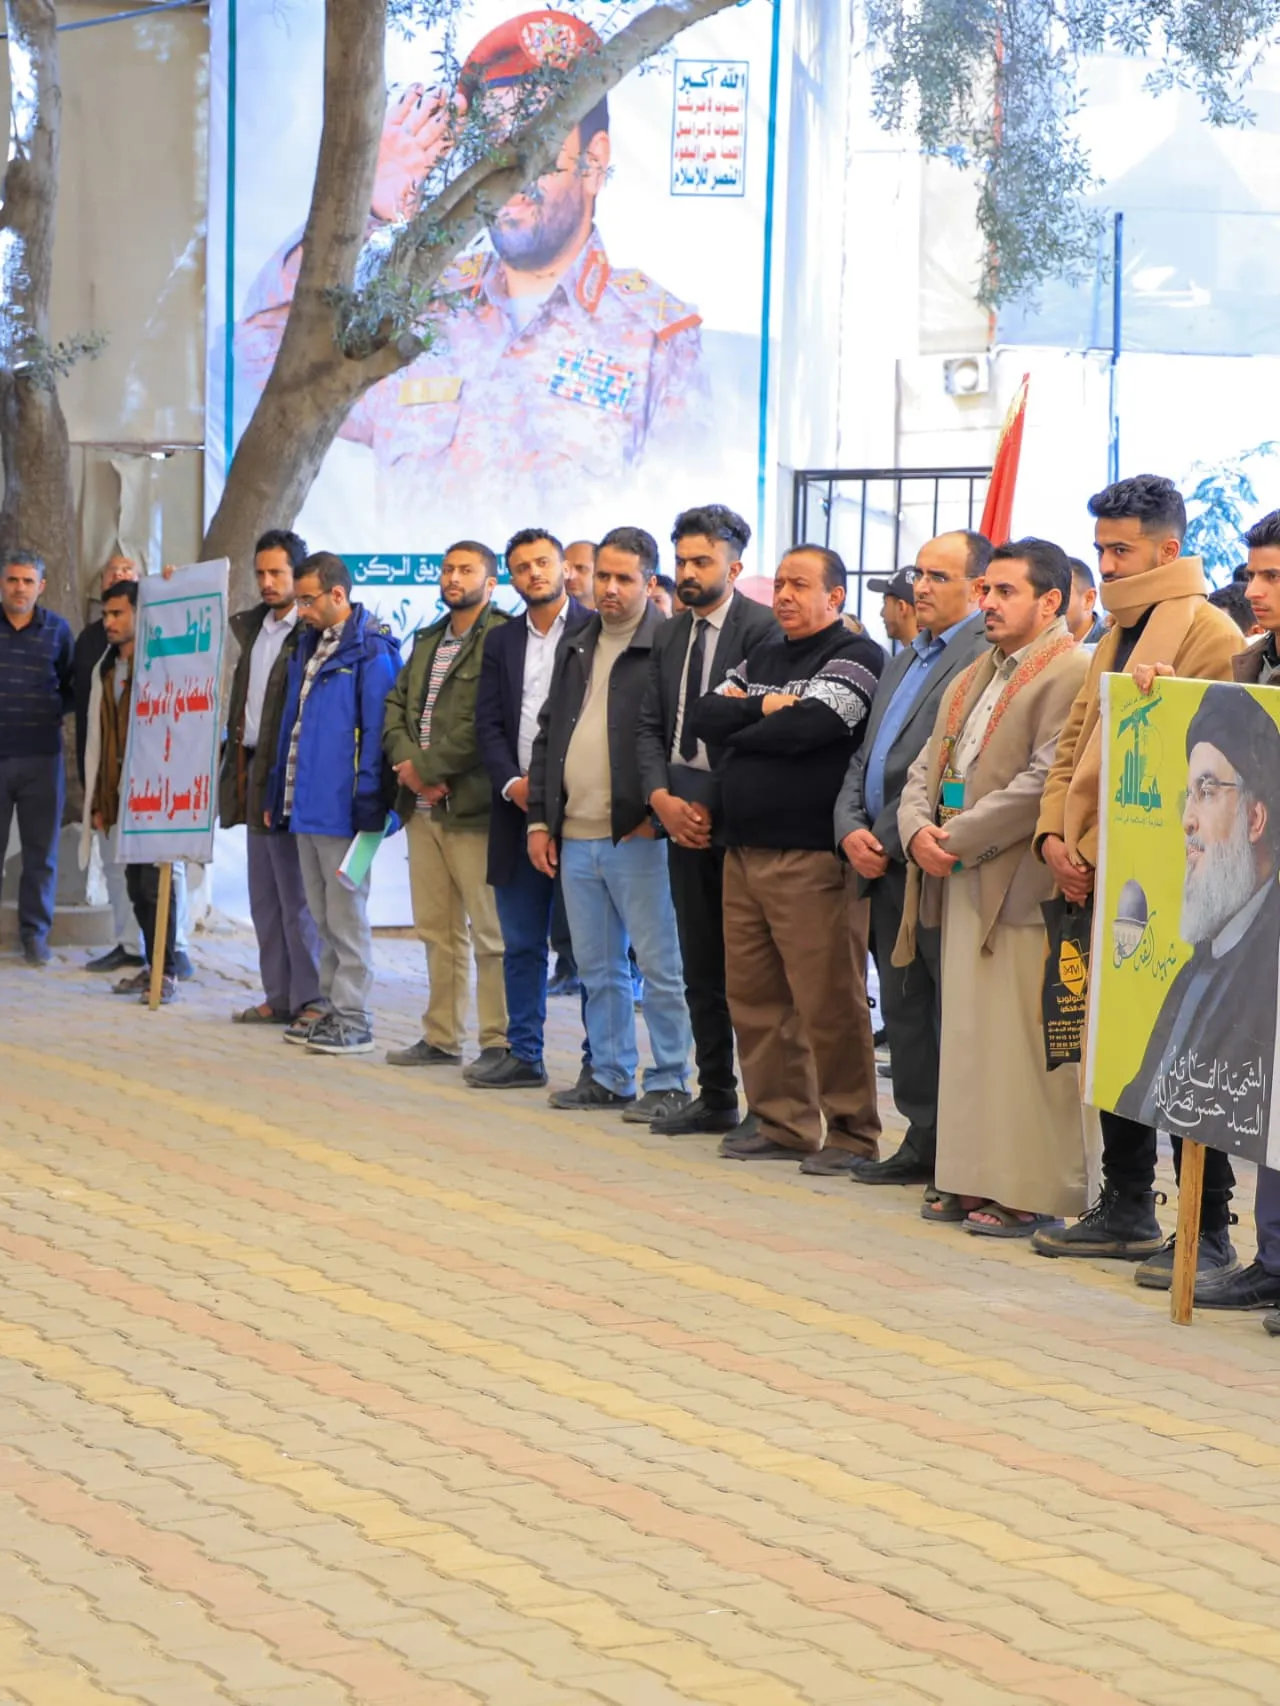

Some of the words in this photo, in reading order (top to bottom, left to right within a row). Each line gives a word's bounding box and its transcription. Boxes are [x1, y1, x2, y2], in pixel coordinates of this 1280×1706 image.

[720, 66, 745, 89] الله
[354, 555, 410, 583] الركن
[143, 604, 212, 672] قاطعوا
[163, 725, 171, 762] و
